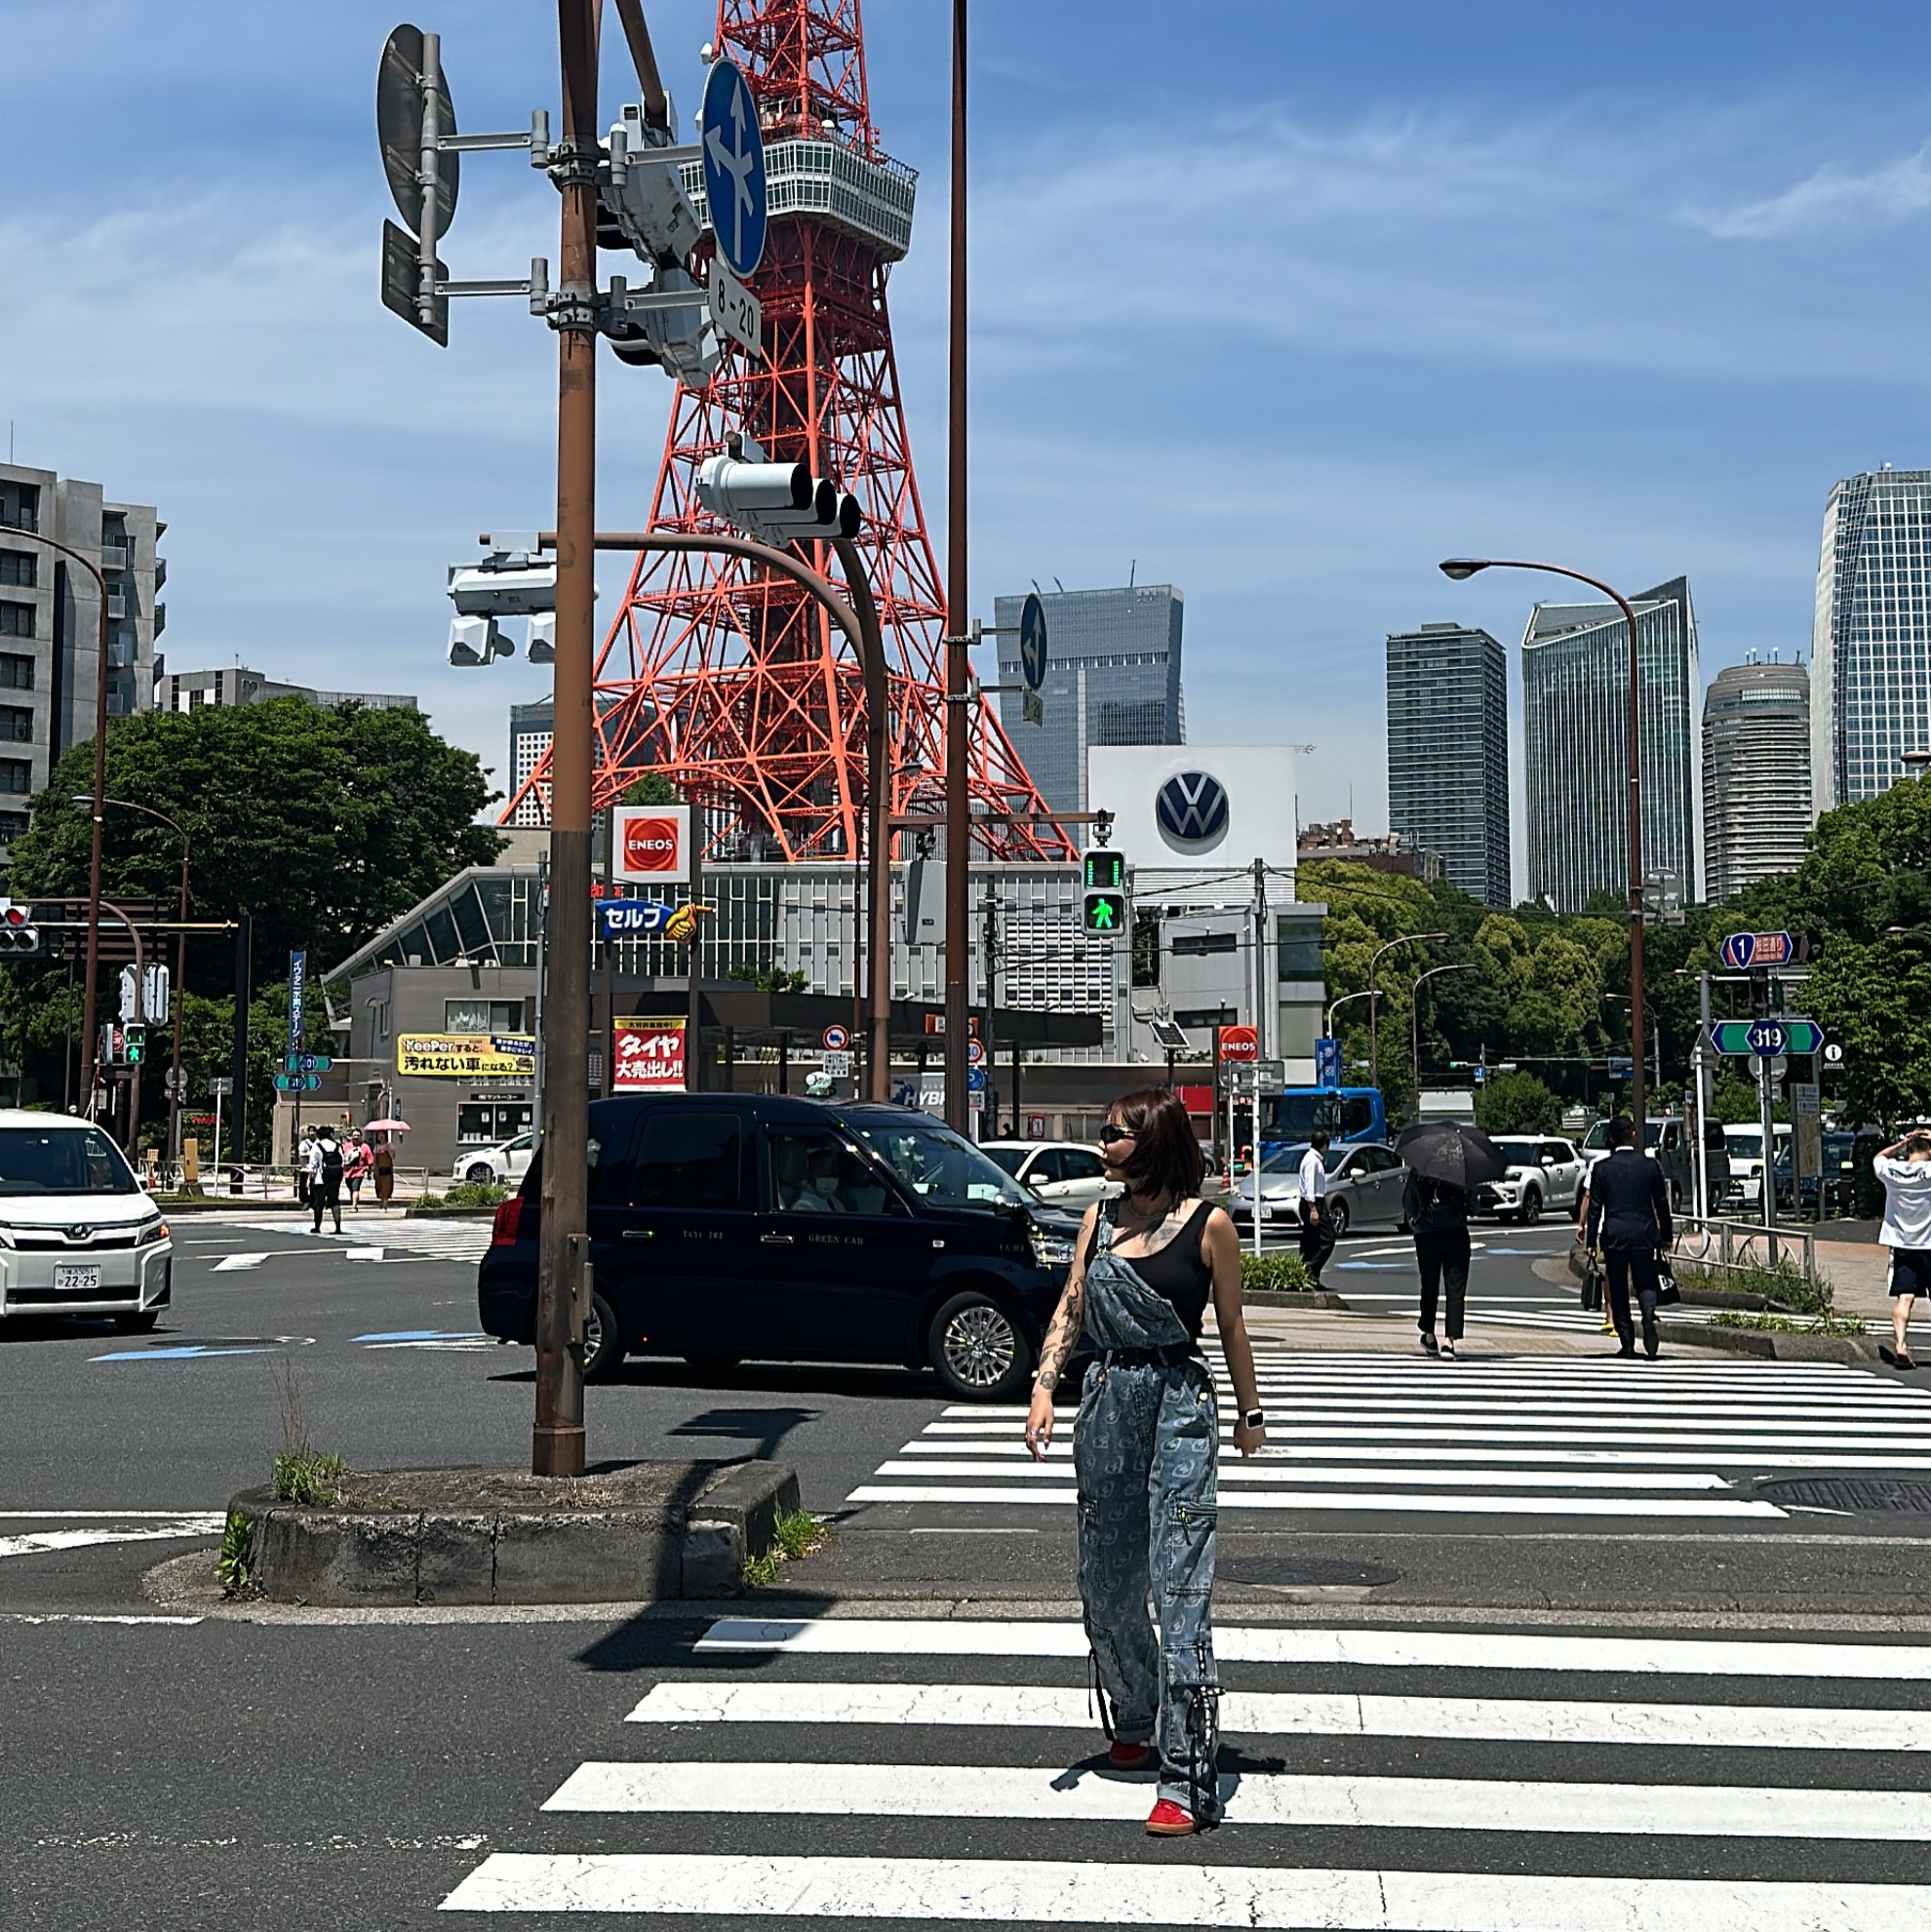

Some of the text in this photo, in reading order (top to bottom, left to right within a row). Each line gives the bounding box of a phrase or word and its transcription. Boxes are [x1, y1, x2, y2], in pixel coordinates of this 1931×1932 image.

[718, 279, 754, 338] 8-20
[628, 840, 674, 850] ENEOS
[606, 908, 660, 928] セルフ
[1738, 938, 1745, 960] 1
[617, 1034, 681, 1058] タイヤ
[1221, 1042, 1256, 1051] ENEOS
[1753, 1028, 1782, 1047] 319
[615, 1059, 684, 1079] 大売出し!!
[808, 1234, 840, 1243] GREEN
[64, 1275, 98, 1287] 22-25
